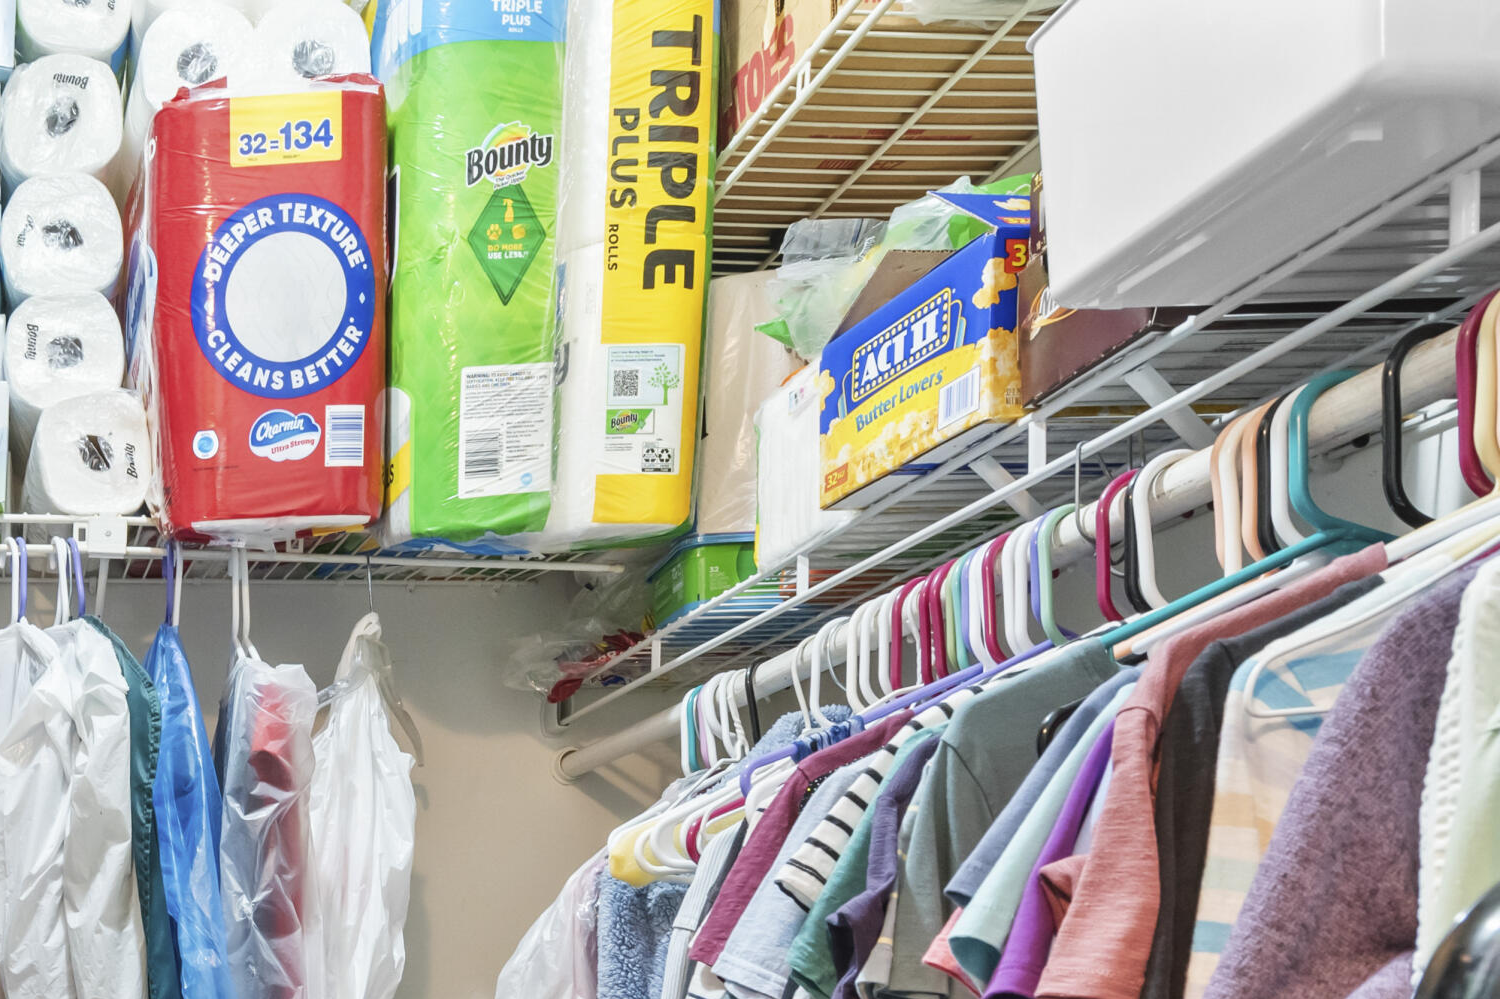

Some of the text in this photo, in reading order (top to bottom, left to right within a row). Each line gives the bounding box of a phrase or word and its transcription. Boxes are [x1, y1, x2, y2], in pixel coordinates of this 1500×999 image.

[492, 0, 543, 14] TRIPLE
[501, 14, 531, 26] PLUS
[466, 133, 553, 186] Bounty
[642, 14, 703, 290] TRIPLE
[607, 108, 640, 271] PLUS ROLLS
[202, 206, 275, 282] DEEPER
[24, 323, 39, 361] Bounty
[207, 329, 285, 390] CLEANS
[860, 308, 941, 386] ACT II
[255, 416, 305, 442] Charmin
[611, 413, 638, 429] Bounty
[855, 397, 898, 432] Butter
[271, 437, 315, 455] Ultra Strong
